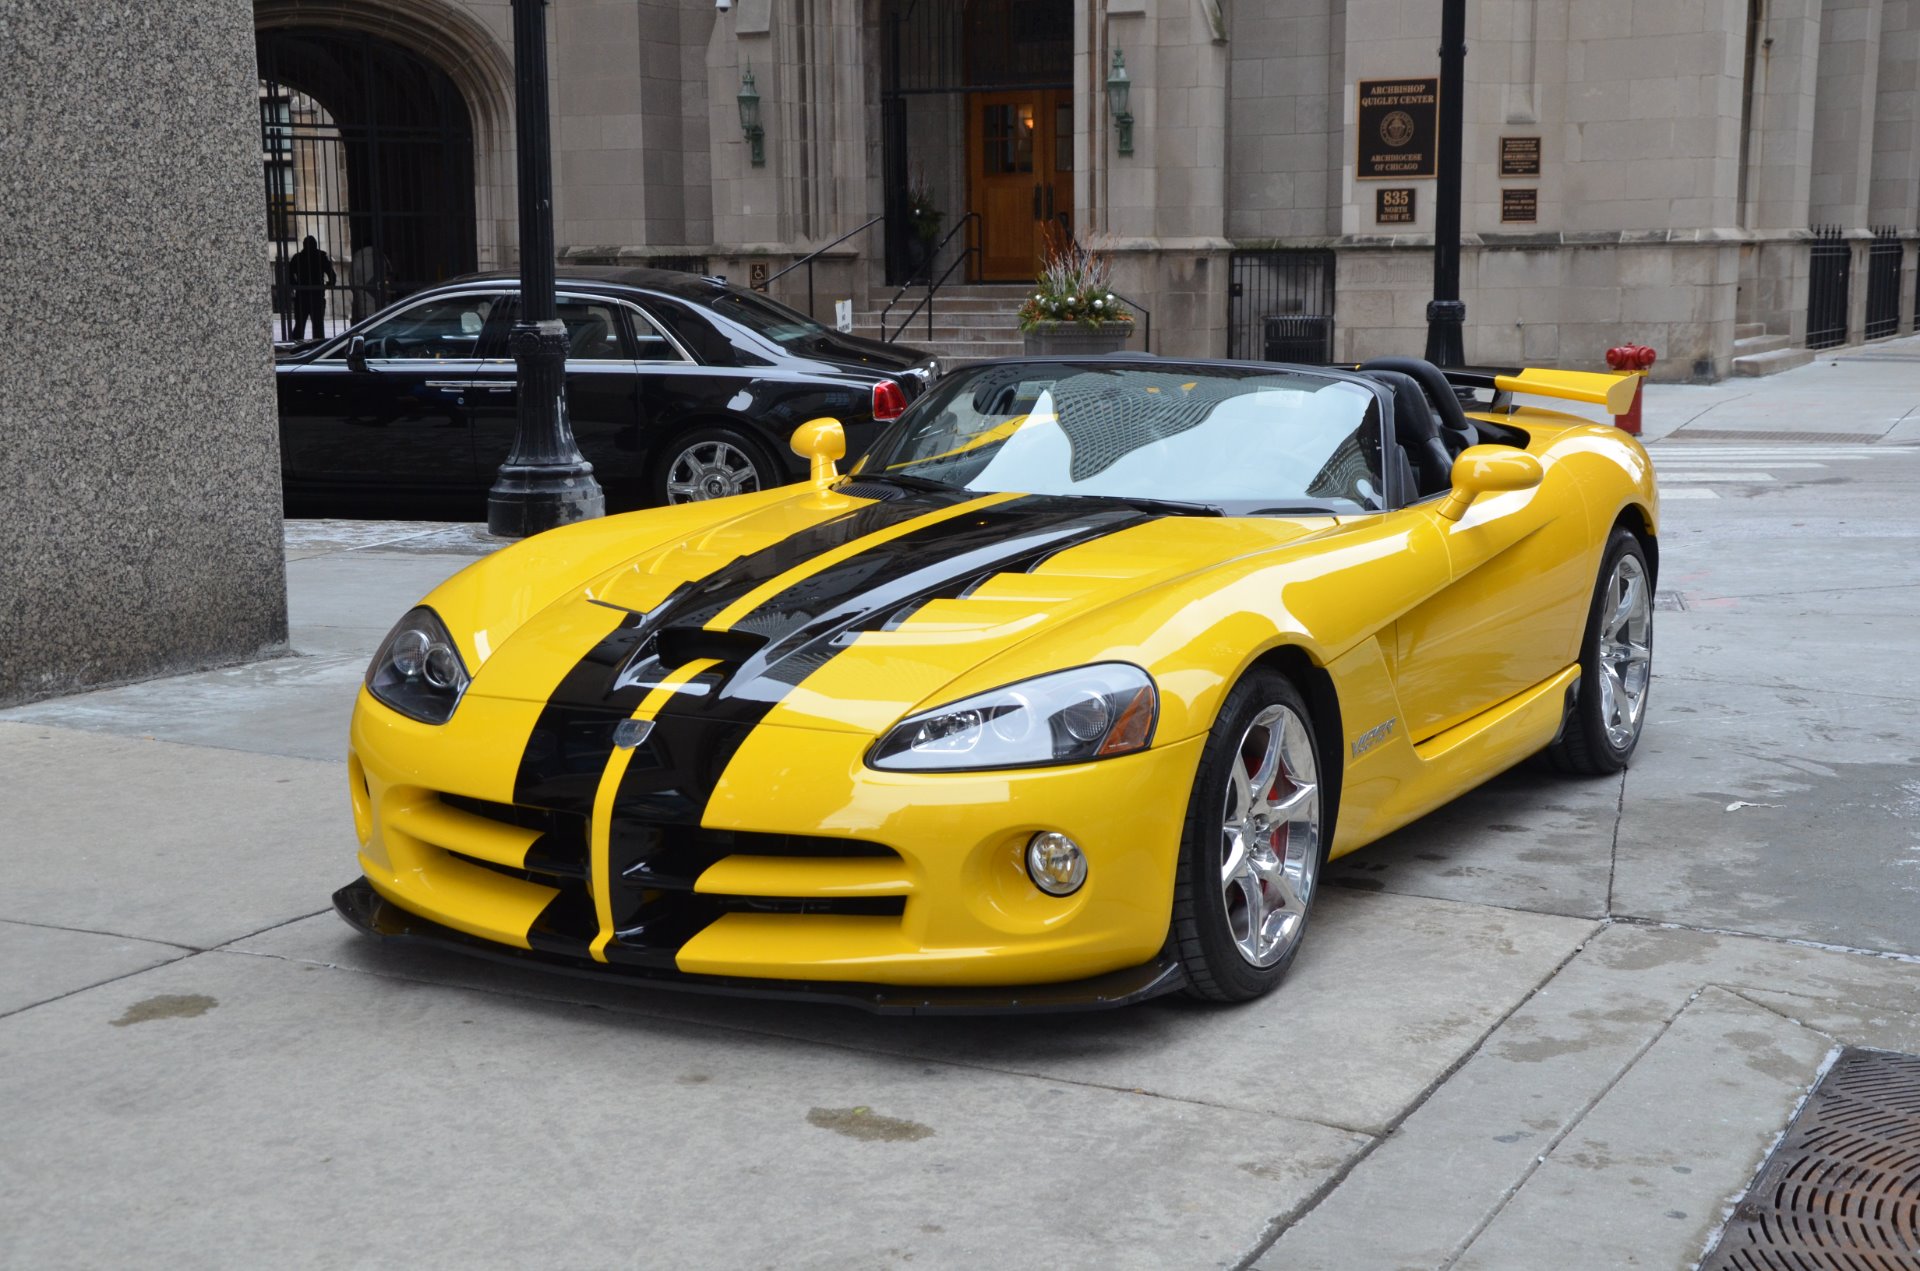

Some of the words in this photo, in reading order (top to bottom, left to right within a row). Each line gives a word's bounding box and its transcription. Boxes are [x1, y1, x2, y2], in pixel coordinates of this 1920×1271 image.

[1371, 85, 1426, 95] ARCHBISHOP
[1362, 96, 1399, 107] QUIGLEY
[1399, 95, 1434, 105] CENTER
[1371, 153, 1422, 162] ARCHDIOCESE
[1385, 163, 1418, 171] CHICAGO
[1383, 190, 1409, 205] 835
[1384, 206, 1408, 214] NORTH
[1351, 716, 1397, 759] VIPER
